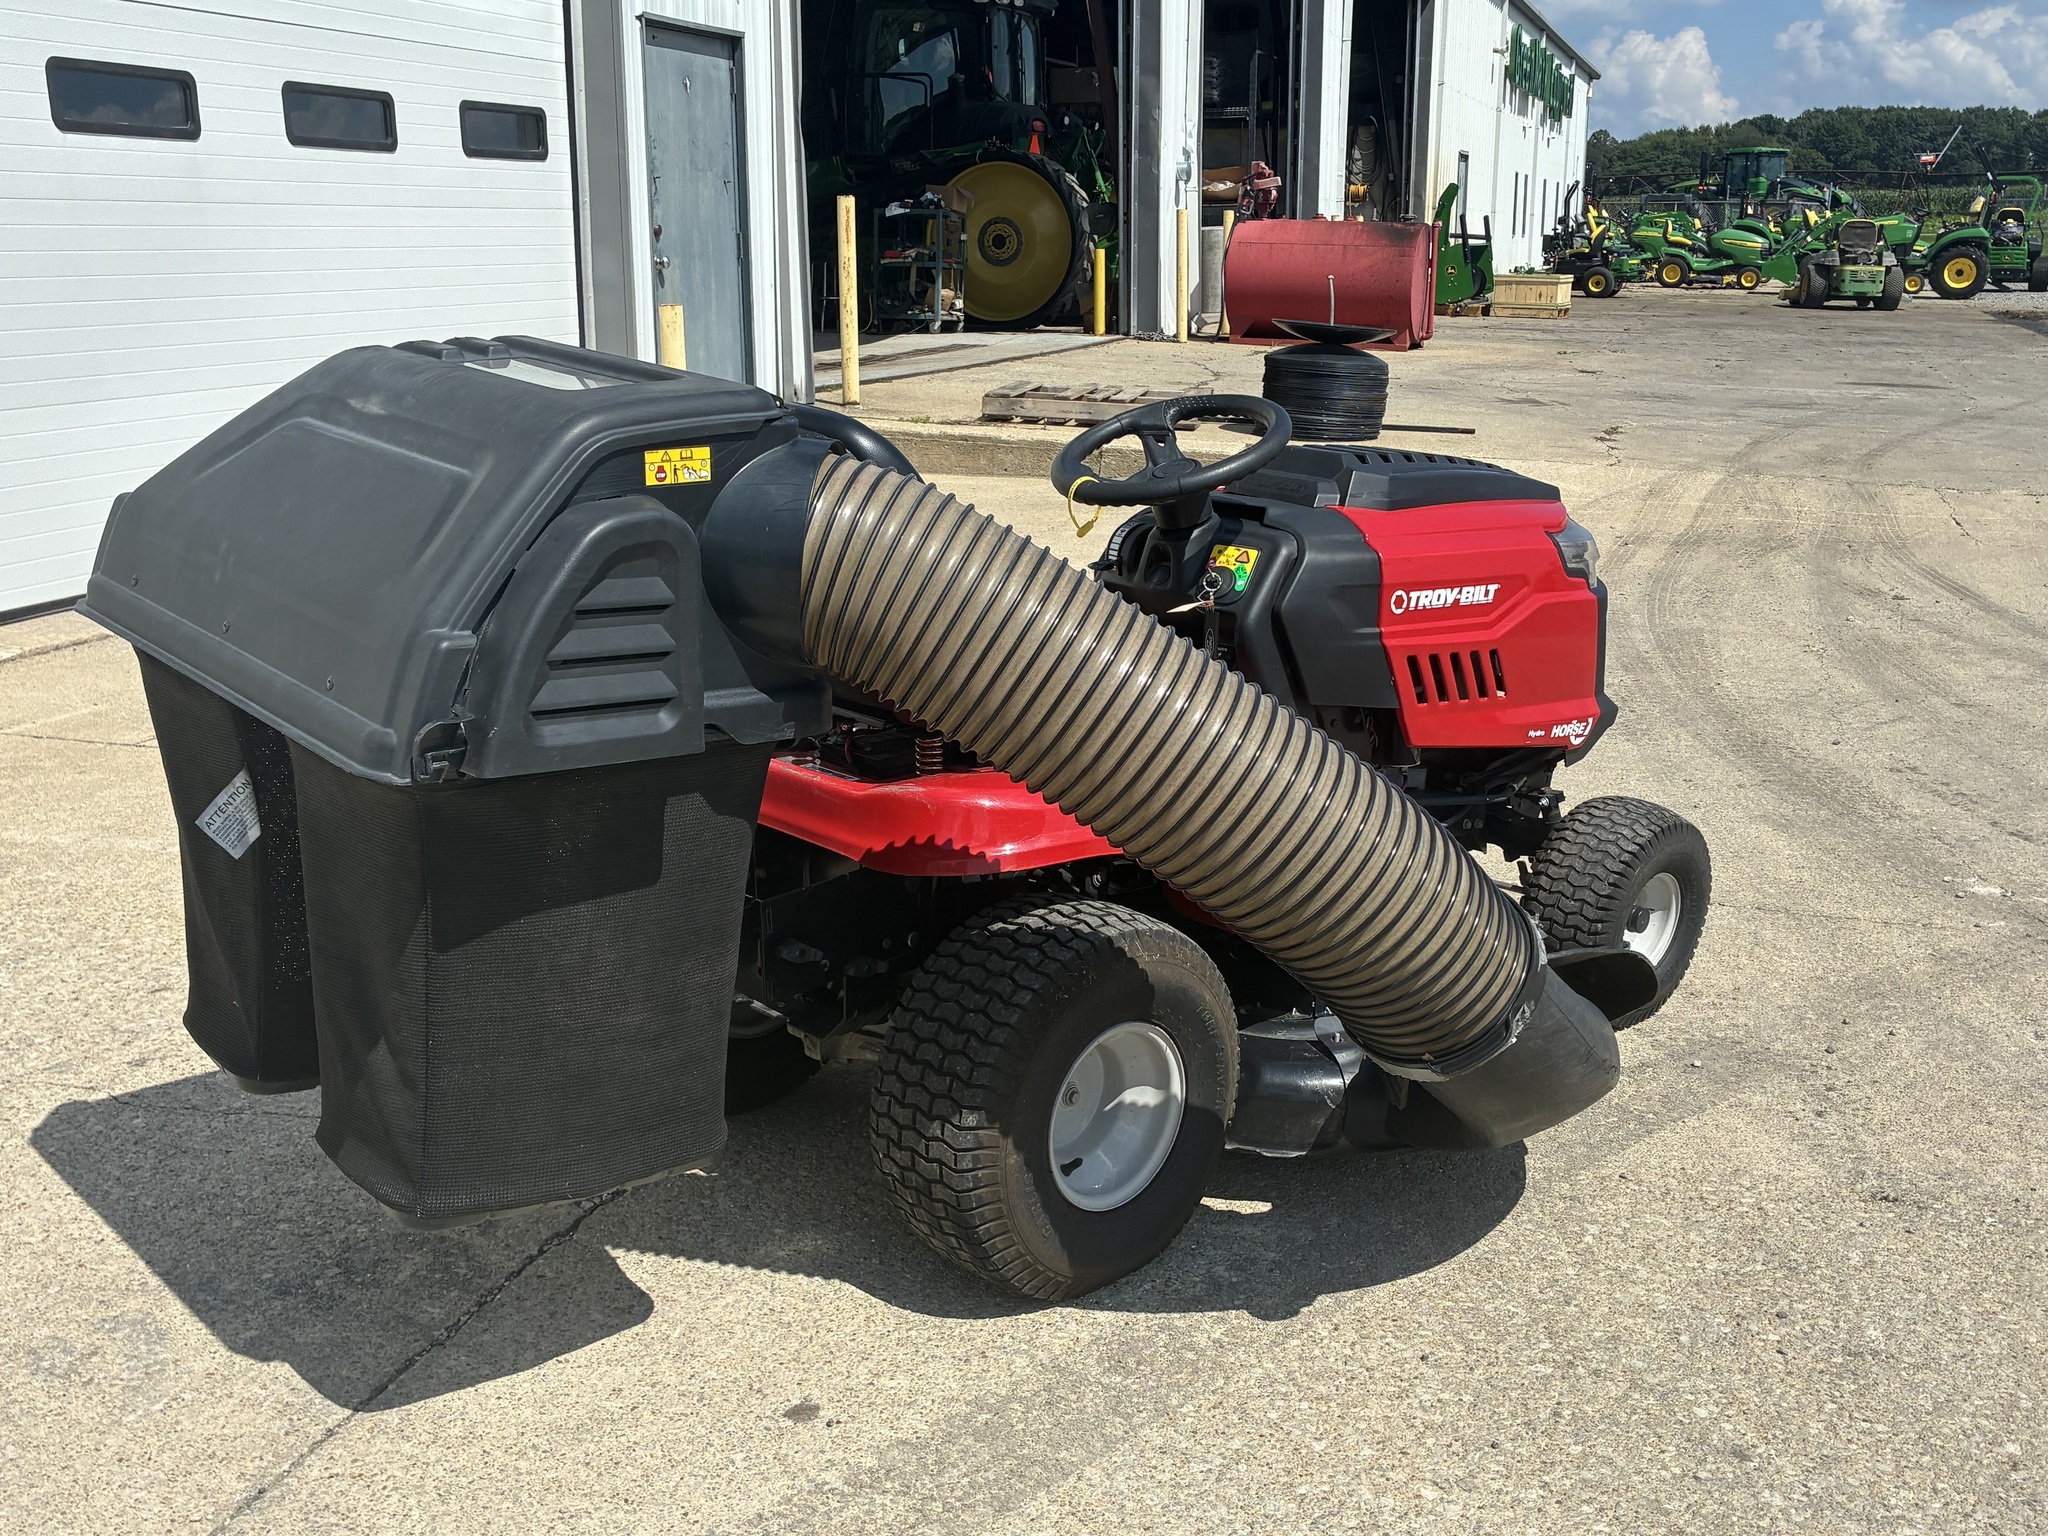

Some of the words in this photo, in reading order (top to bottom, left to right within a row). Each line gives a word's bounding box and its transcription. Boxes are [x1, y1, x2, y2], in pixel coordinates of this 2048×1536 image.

[1409, 584, 1499, 610] TROY-BILT
[1528, 730, 1546, 738] Hydro
[1551, 722, 1586, 738] HORSE
[205, 779, 252, 830] ATTENTION
